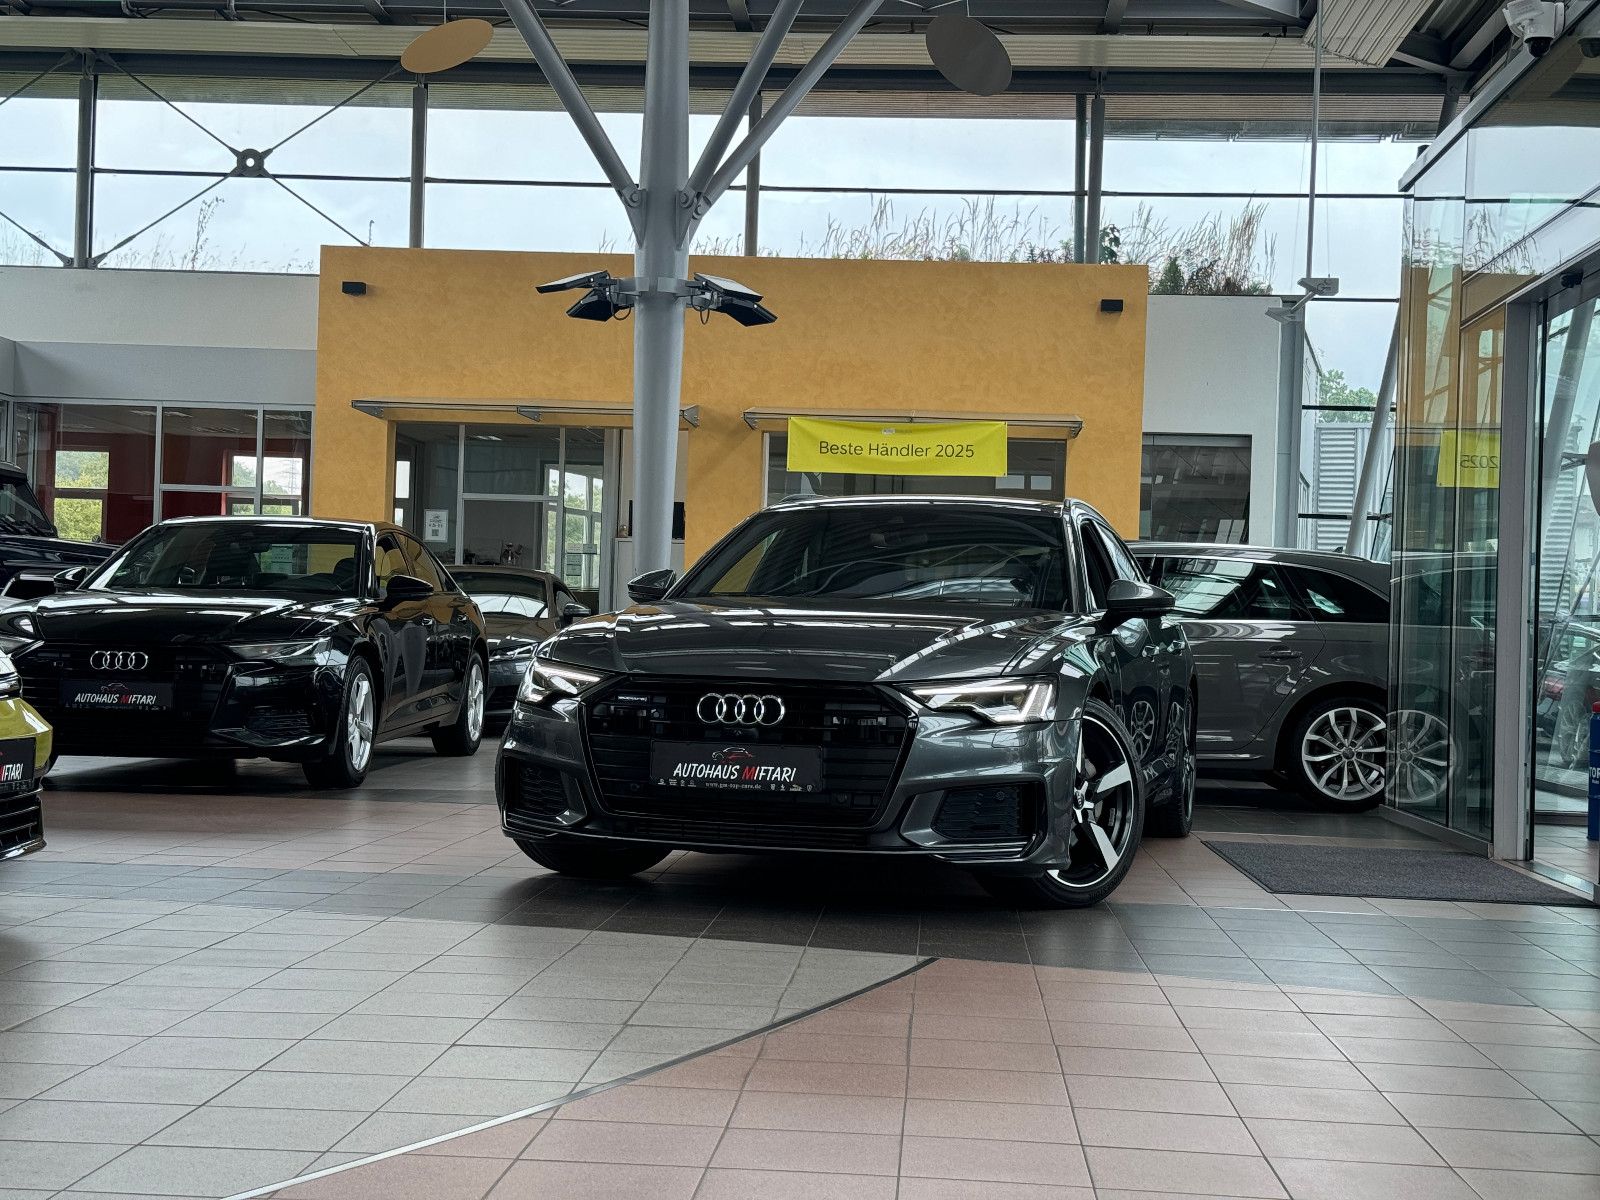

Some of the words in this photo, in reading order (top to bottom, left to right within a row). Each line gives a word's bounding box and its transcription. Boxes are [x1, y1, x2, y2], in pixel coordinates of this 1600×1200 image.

[819, 441, 864, 456] Beste
[868, 443, 931, 457] Händler
[935, 444, 974, 458] 2025
[75, 693, 120, 704] AUTOHAUS
[120, 694, 157, 705] MIFTARI
[673, 763, 740, 781] AUTOHAUS
[742, 766, 797, 782] MIFTARI
